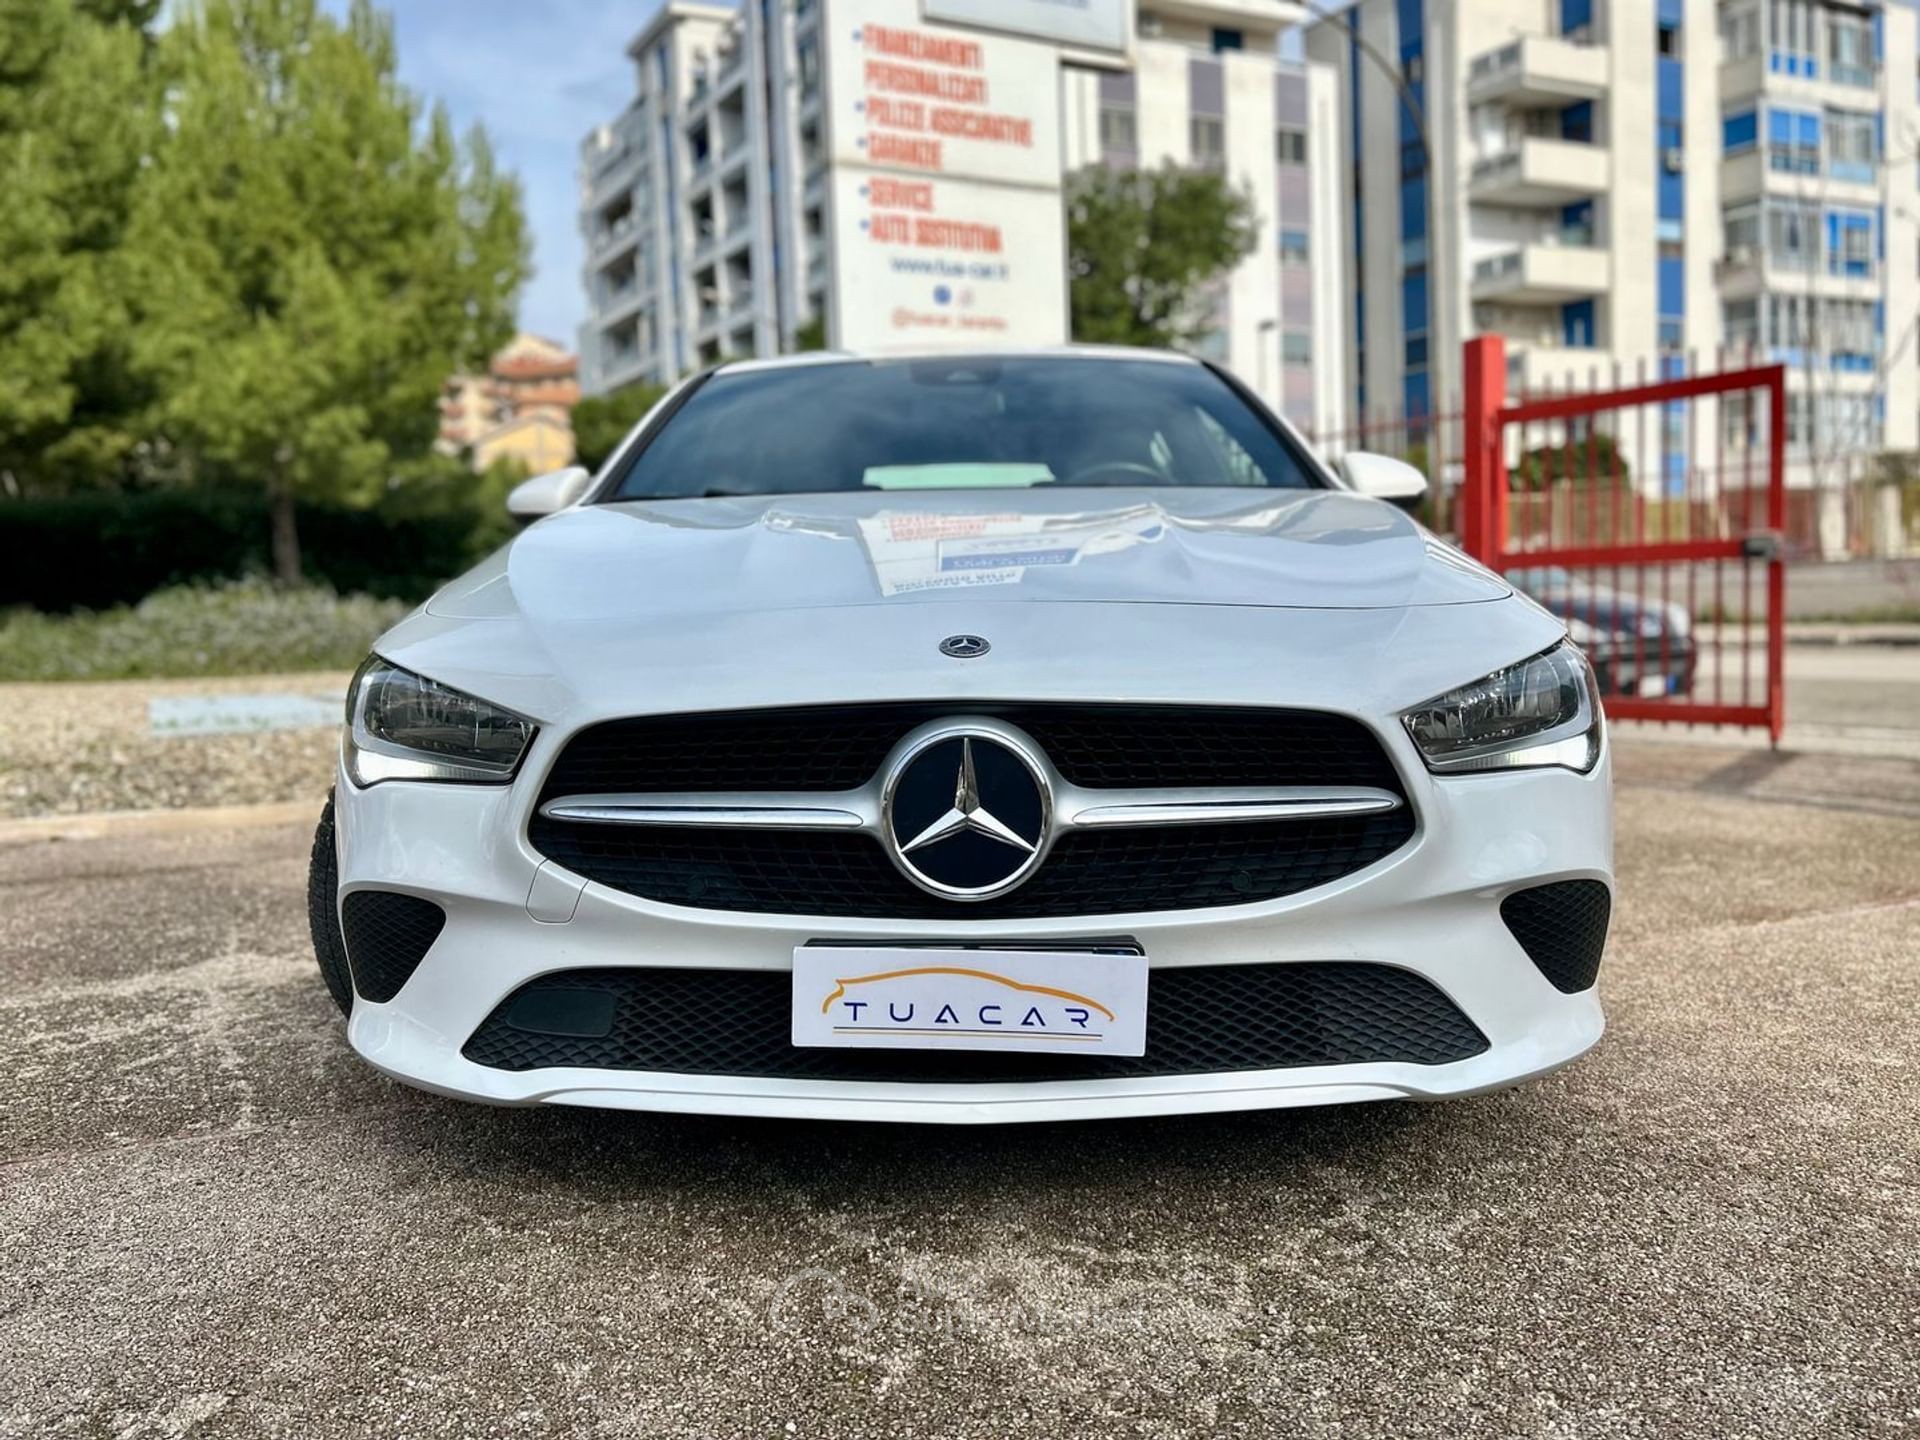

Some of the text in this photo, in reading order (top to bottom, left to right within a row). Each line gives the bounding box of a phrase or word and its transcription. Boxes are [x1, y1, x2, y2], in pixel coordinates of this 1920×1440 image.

[868, 177, 933, 212] SERVICE
[869, 214, 910, 245] AUTO
[844, 1002, 1090, 1028] TUACAR
